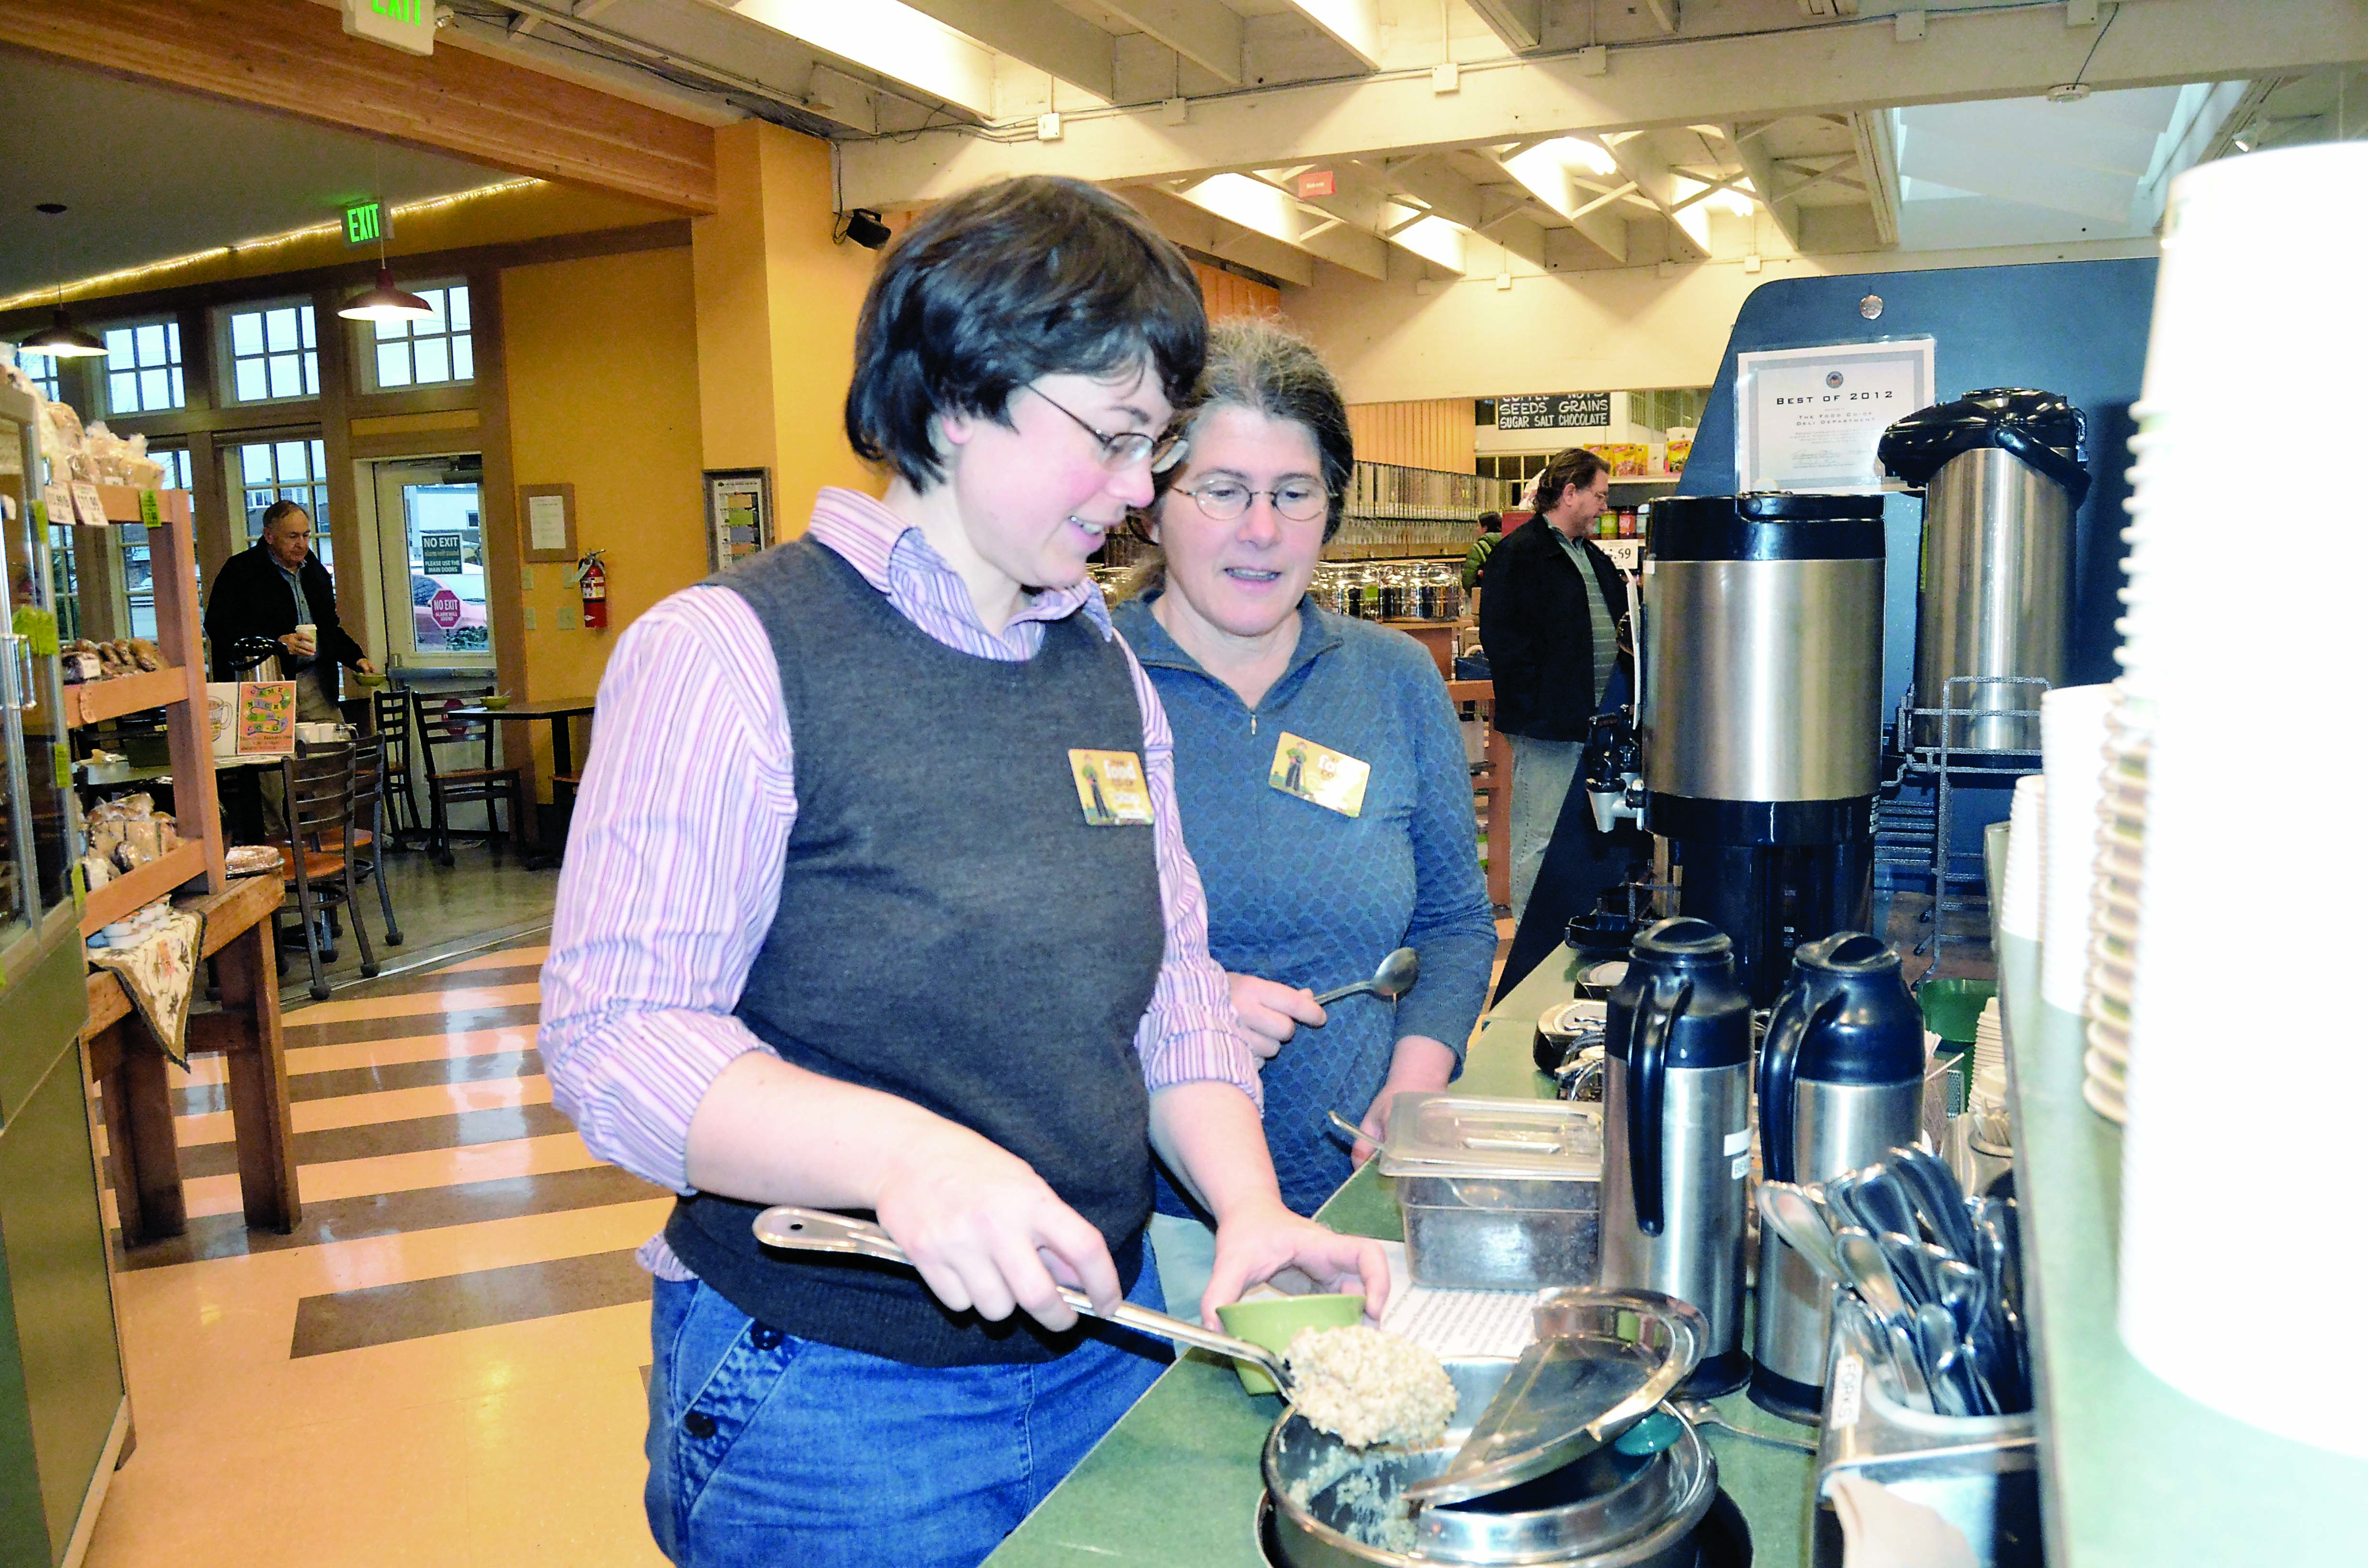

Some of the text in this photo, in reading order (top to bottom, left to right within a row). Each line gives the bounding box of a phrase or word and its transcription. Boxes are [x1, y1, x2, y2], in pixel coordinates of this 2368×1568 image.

[347, 203, 379, 242] EXIT
[1776, 396, 1813, 405] BEST
[1850, 391, 1893, 400] 2012
[1499, 399, 1608, 415] SEEDS GRAINS
[1499, 412, 1608, 429] SUGAR SALT CHOCOLATE
[423, 537, 458, 548] NO EXIT
[434, 599, 457, 610] NO EXIT
[250, 687, 283, 696] GAME
[1838, 1363, 1857, 1420] FORKS
